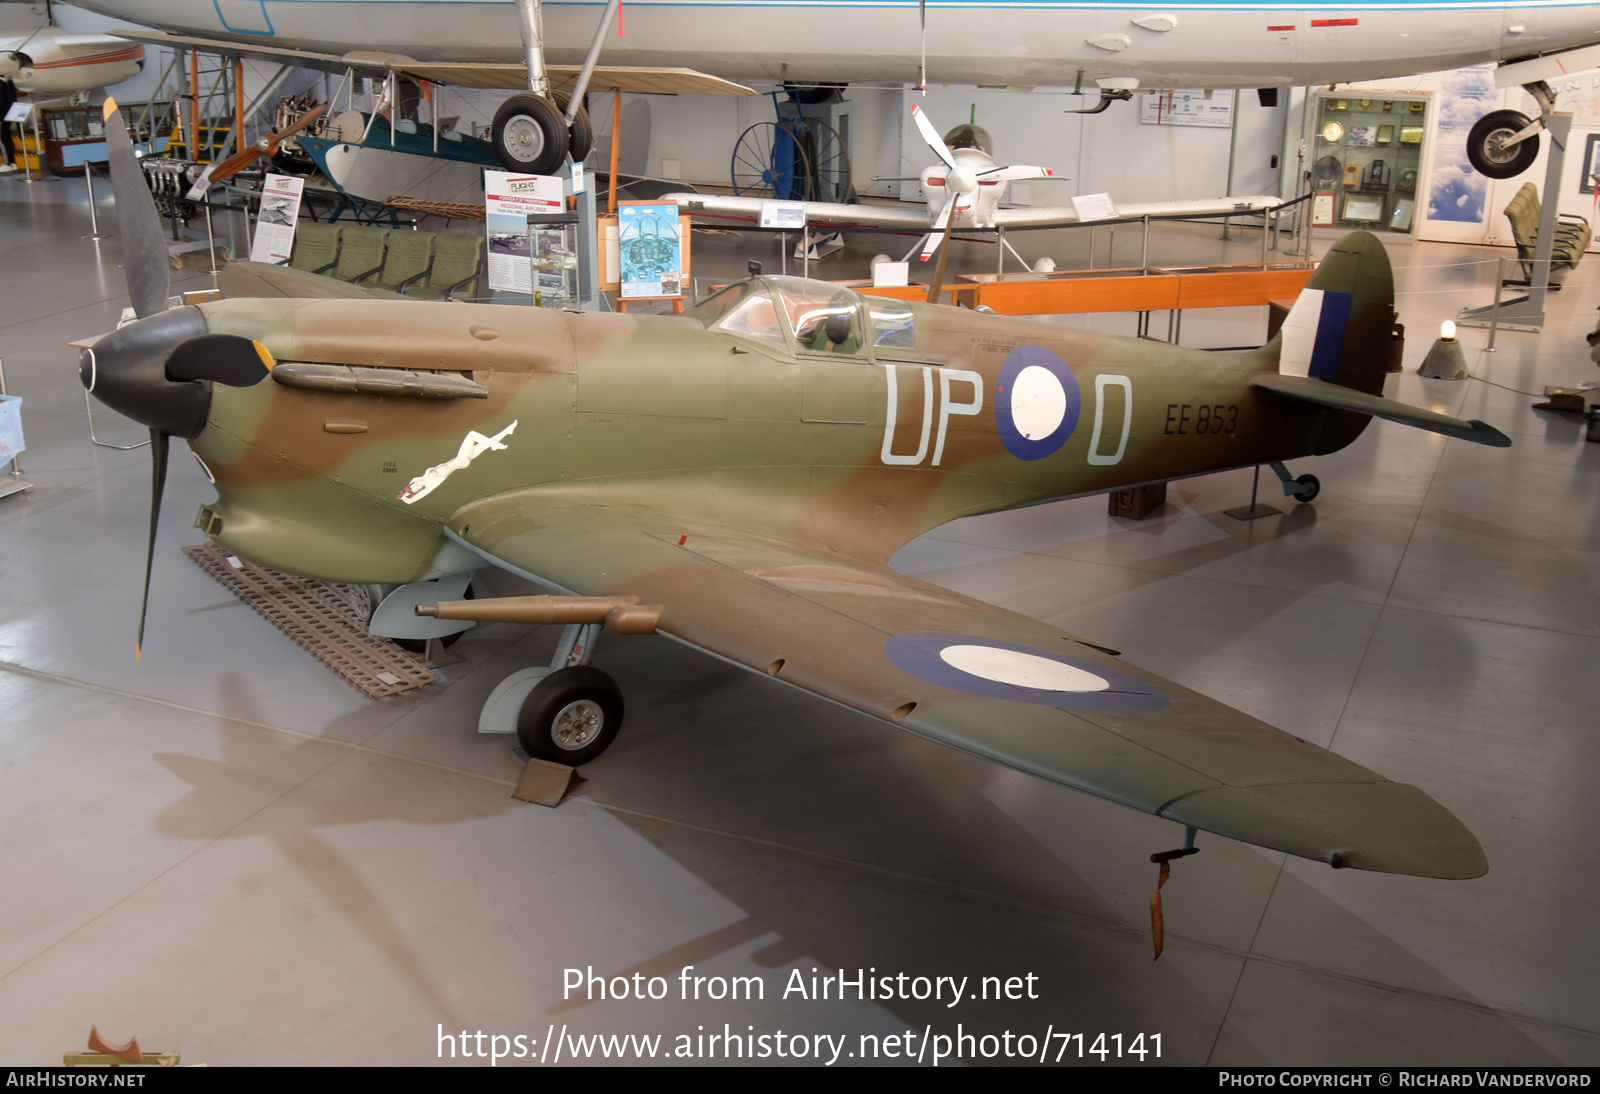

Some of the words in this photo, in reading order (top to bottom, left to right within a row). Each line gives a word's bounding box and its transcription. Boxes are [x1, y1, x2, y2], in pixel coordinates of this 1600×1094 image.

[511, 182, 534, 190] FLIGHT
[501, 203, 525, 211] REGIONAL
[881, 364, 984, 466] UP
[1164, 403, 1191, 435] EE
[1195, 404, 1239, 435] 853
